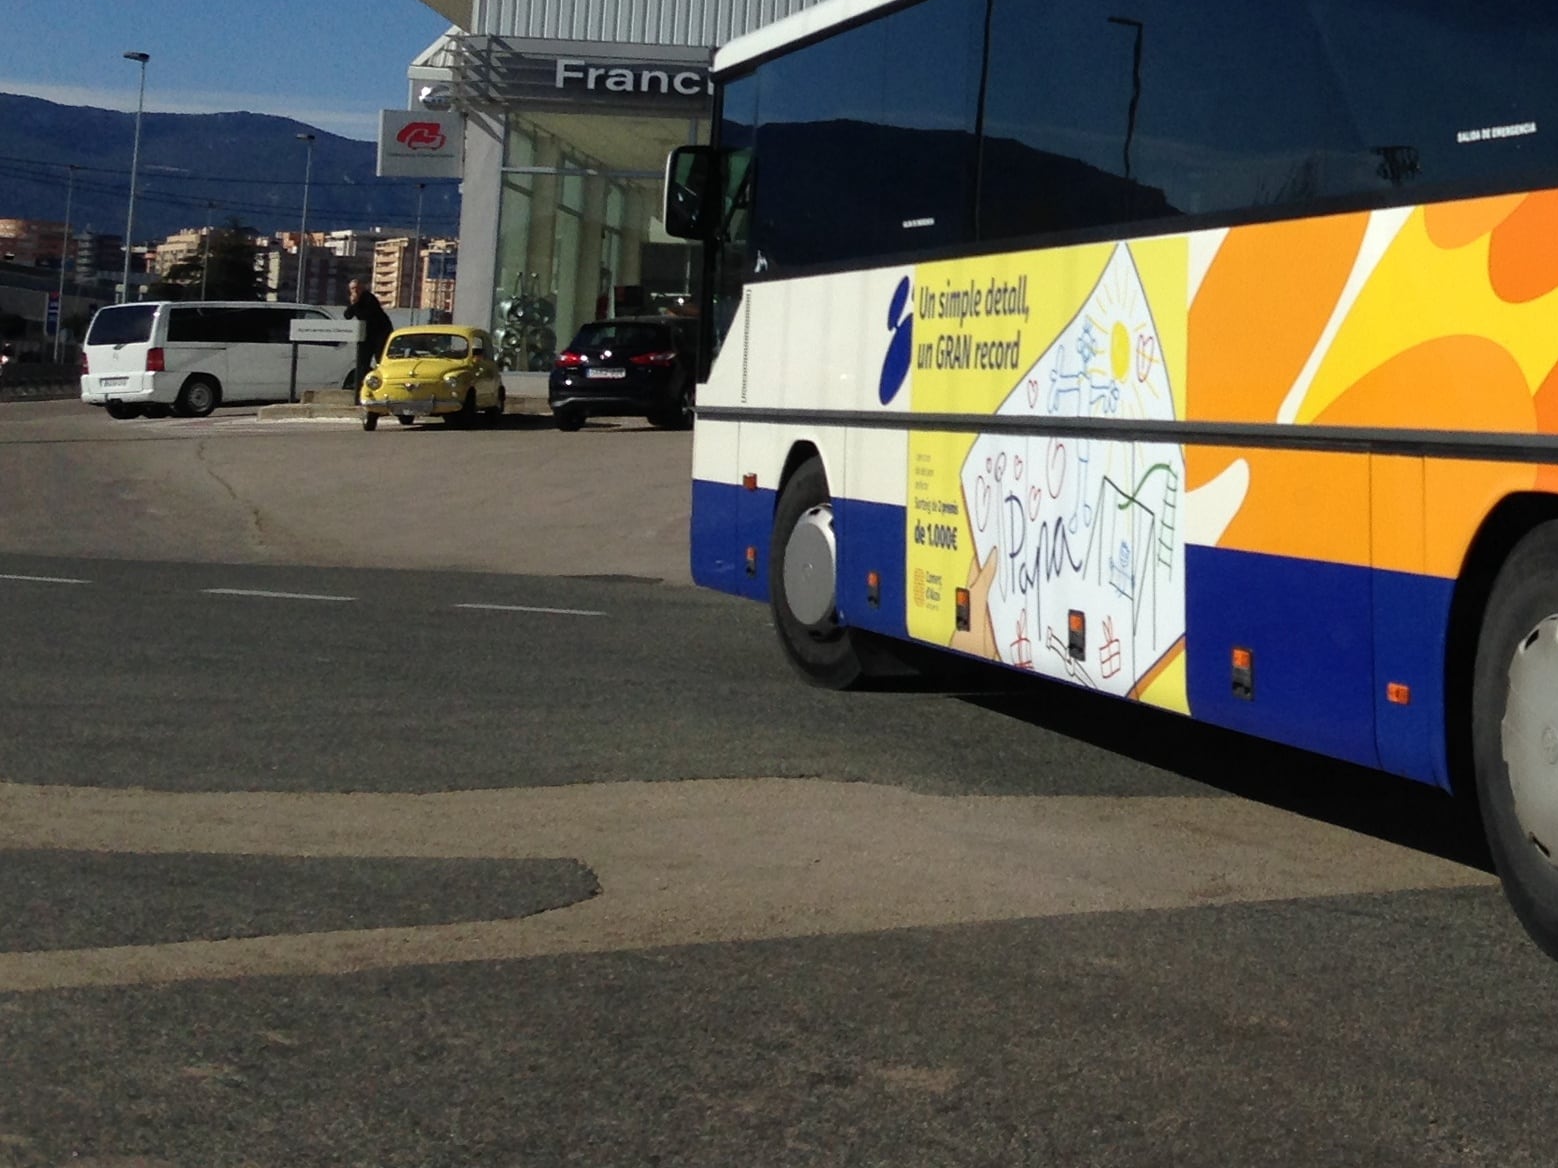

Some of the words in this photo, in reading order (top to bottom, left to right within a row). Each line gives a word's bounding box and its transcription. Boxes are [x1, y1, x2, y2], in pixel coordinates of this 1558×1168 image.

[919, 285, 936, 320] Un
[938, 278, 982, 329] simple
[985, 274, 1029, 324] detall,
[917, 343, 933, 370] un
[936, 334, 973, 370] GRAN
[974, 329, 1021, 370] record
[914, 519, 925, 545] de
[927, 524, 958, 551] 1.000€
